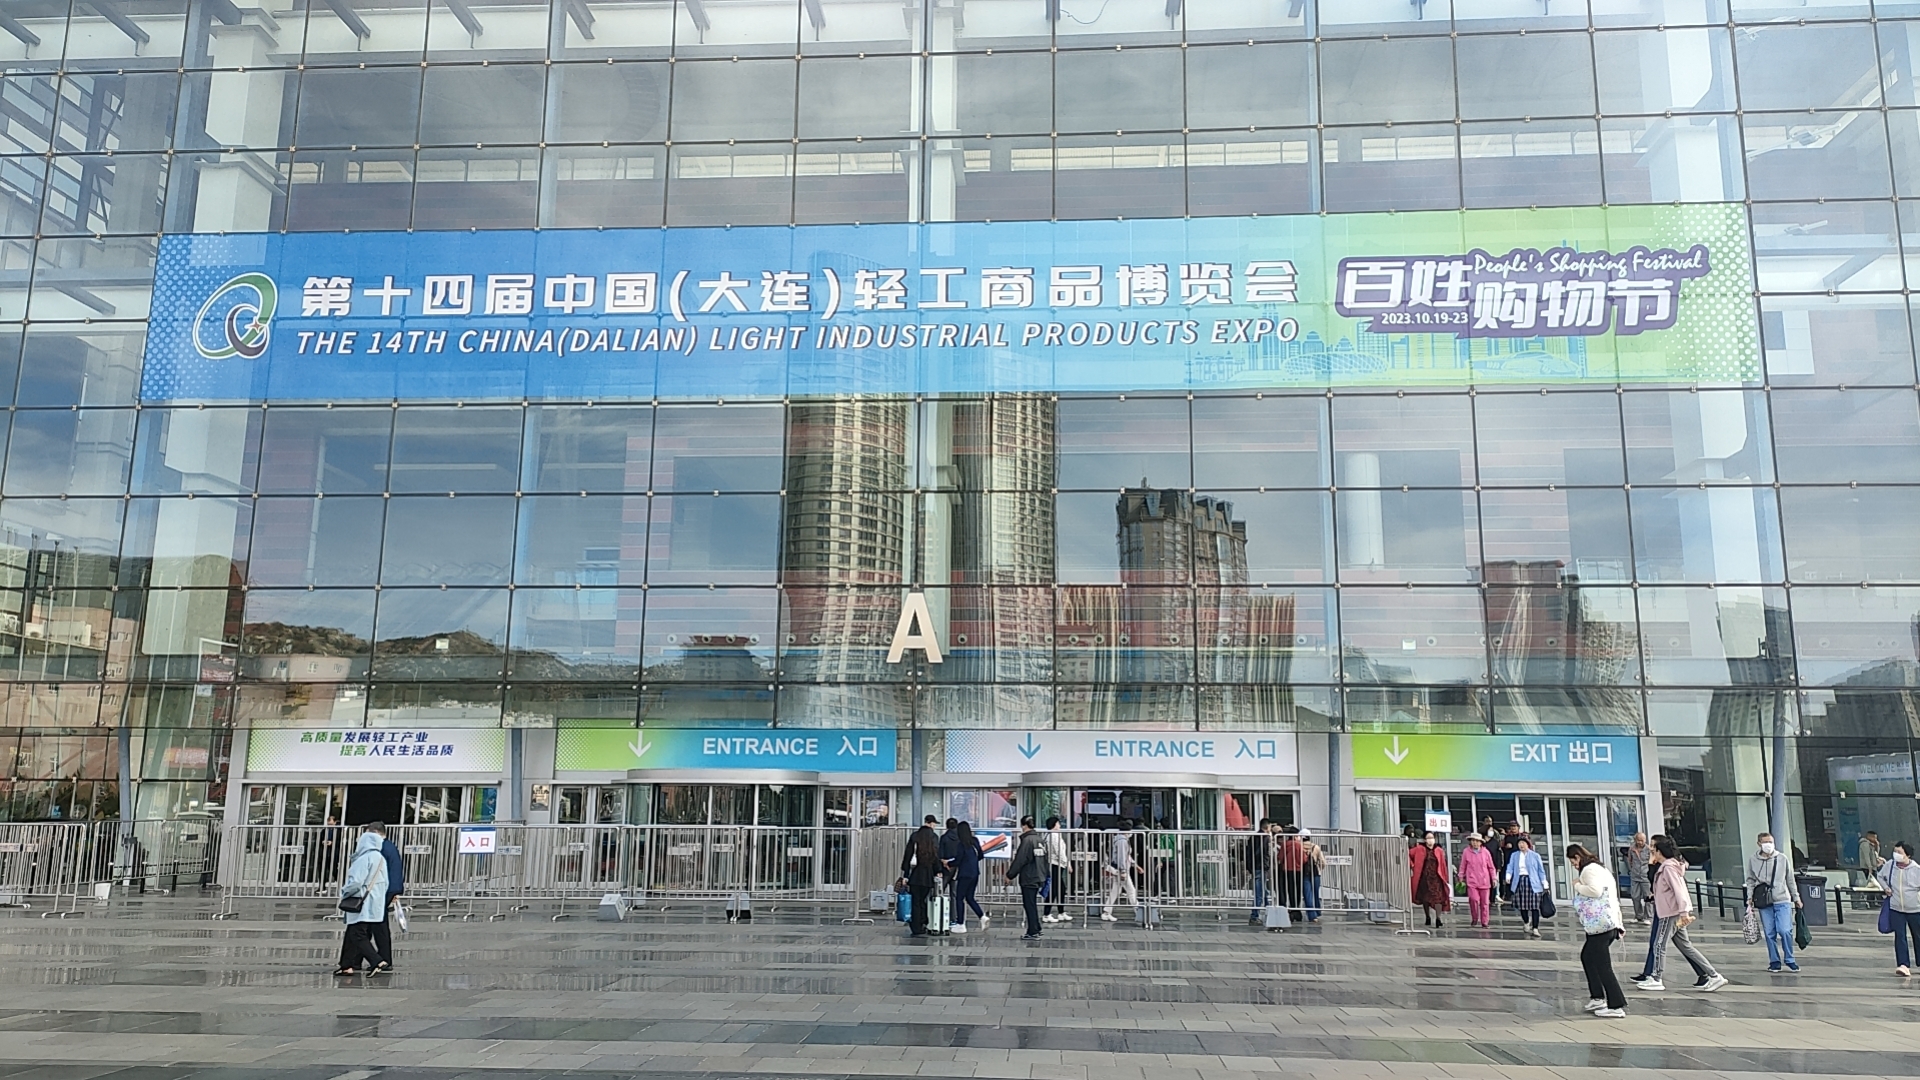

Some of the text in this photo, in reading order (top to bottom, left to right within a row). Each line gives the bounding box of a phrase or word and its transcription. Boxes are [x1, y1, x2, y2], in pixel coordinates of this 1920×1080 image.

[1474, 250, 1703, 278] People's Shopping Festival
[1343, 260, 1674, 330] 百姓 购物节
[1381, 312, 1469, 325] 2023.10.19-23
[297, 317, 1300, 357] THE 14TH CHINA(DALIAN) LIGHT INDUSTRIAL PRODUCTS EXPO
[886, 592, 944, 663] A
[300, 731, 429, 743] 高质量发展轻工产业
[703, 735, 878, 757] ENTRANCE 入口
[340, 744, 454, 757] 提高人民生活品质
[1095, 738, 1276, 759] ENTRANCE 入口
[1510, 740, 1612, 764] EXIT 出口
[1429, 818, 1448, 828] 出口
[465, 836, 490, 848] 入口
